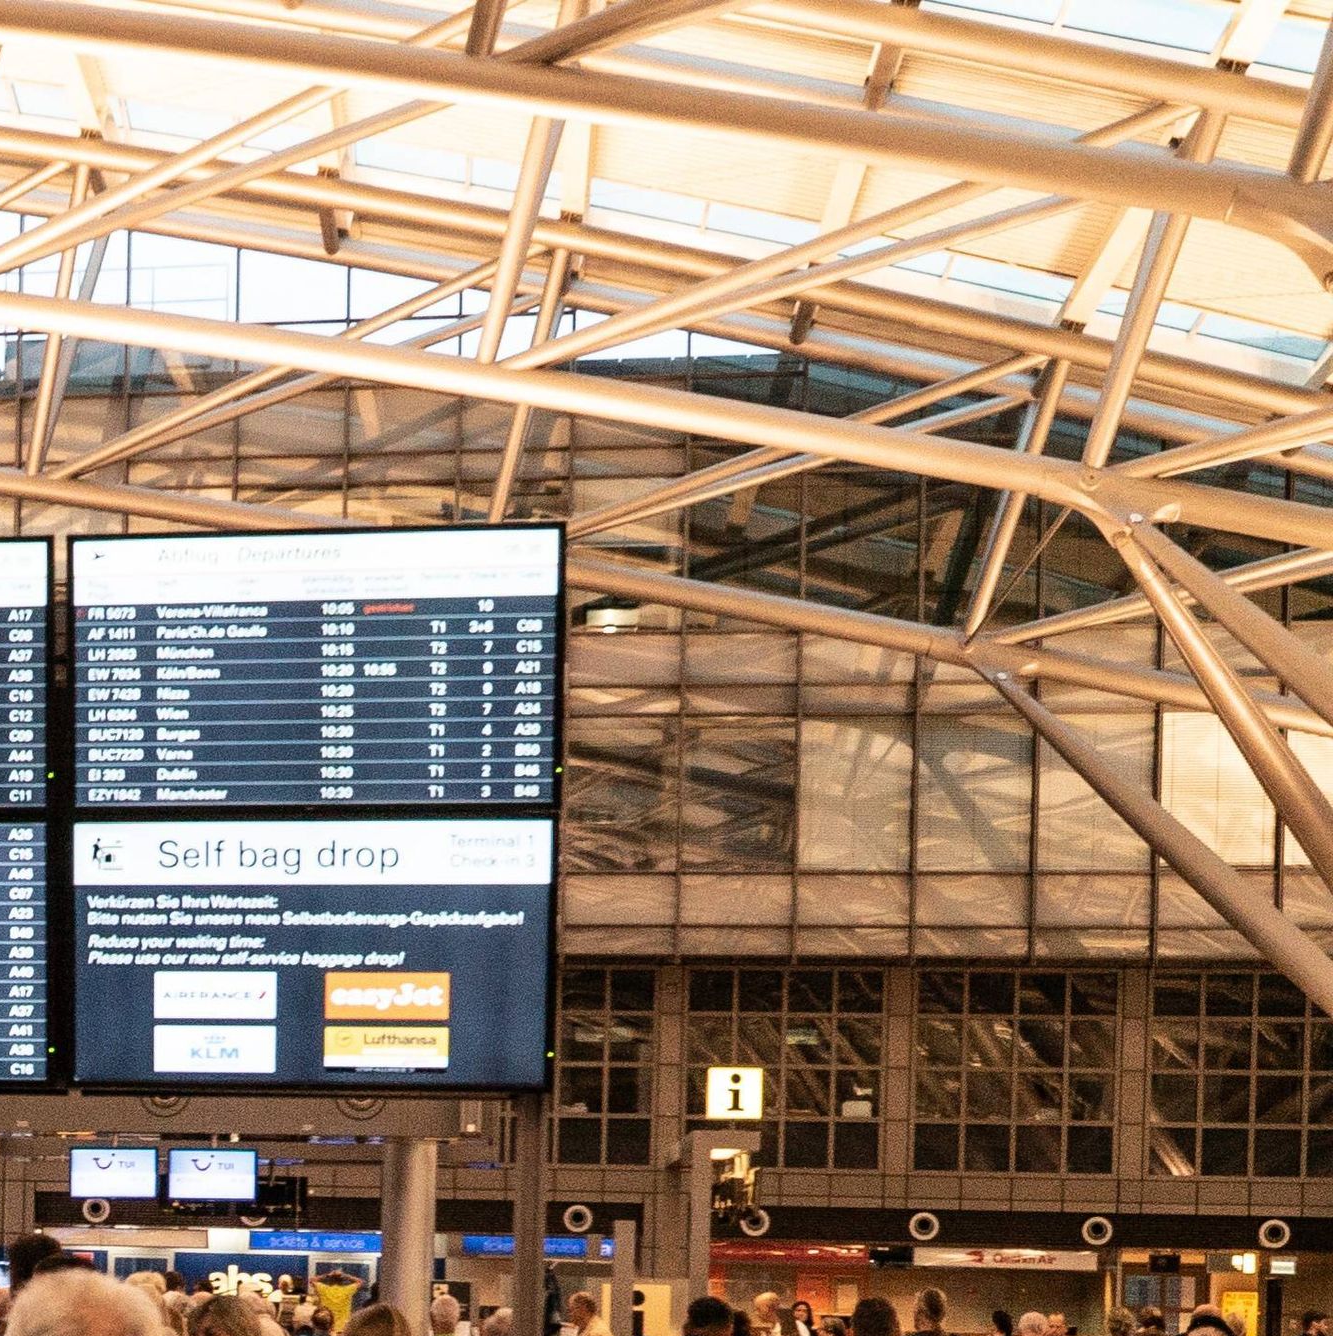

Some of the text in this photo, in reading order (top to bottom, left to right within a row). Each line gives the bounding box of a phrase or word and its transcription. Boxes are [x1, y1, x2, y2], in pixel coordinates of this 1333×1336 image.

[238, 545, 342, 563] Departures
[7, 608, 33, 622] A17
[107, 626, 136, 640] 1411
[320, 621, 355, 636] 10:10
[428, 619, 447, 634] T1
[155, 639, 494, 660] München T2 7
[8, 708, 33, 723] C12
[480, 743, 492, 757] 2
[427, 763, 445, 778] T1
[8, 788, 32, 802] C11
[449, 833, 521, 848] Terminal
[158, 840, 400, 875] Self bag drop
[87, 895, 155, 909] Verkürzen
[156, 895, 181, 909] Sie
[182, 895, 210, 909] Ihre
[87, 911, 120, 926] Bitte
[121, 912, 168, 926] nutzen
[169, 911, 194, 926] Sie
[195, 914, 243, 926] unsere
[244, 914, 281, 926] neue
[87, 933, 141, 949] Reduce
[141, 936, 176, 951] your
[176, 934, 228, 952] waiting
[87, 951, 134, 965] Please
[134, 954, 161, 965] use
[161, 954, 189, 965] our
[188, 954, 221, 965] new
[221, 951, 301, 966] self-service
[301, 951, 364, 968] baggage
[8, 984, 34, 998] A17
[329, 982, 444, 1012] easyJet
[363, 1032, 437, 1047] Lufthansa
[190, 1046, 240, 1060] KLM
[118, 1160, 136, 1169] TUI
[217, 1162, 235, 1170] TUI
[311, 1238, 321, 1248] &
[324, 1238, 366, 1250] service
